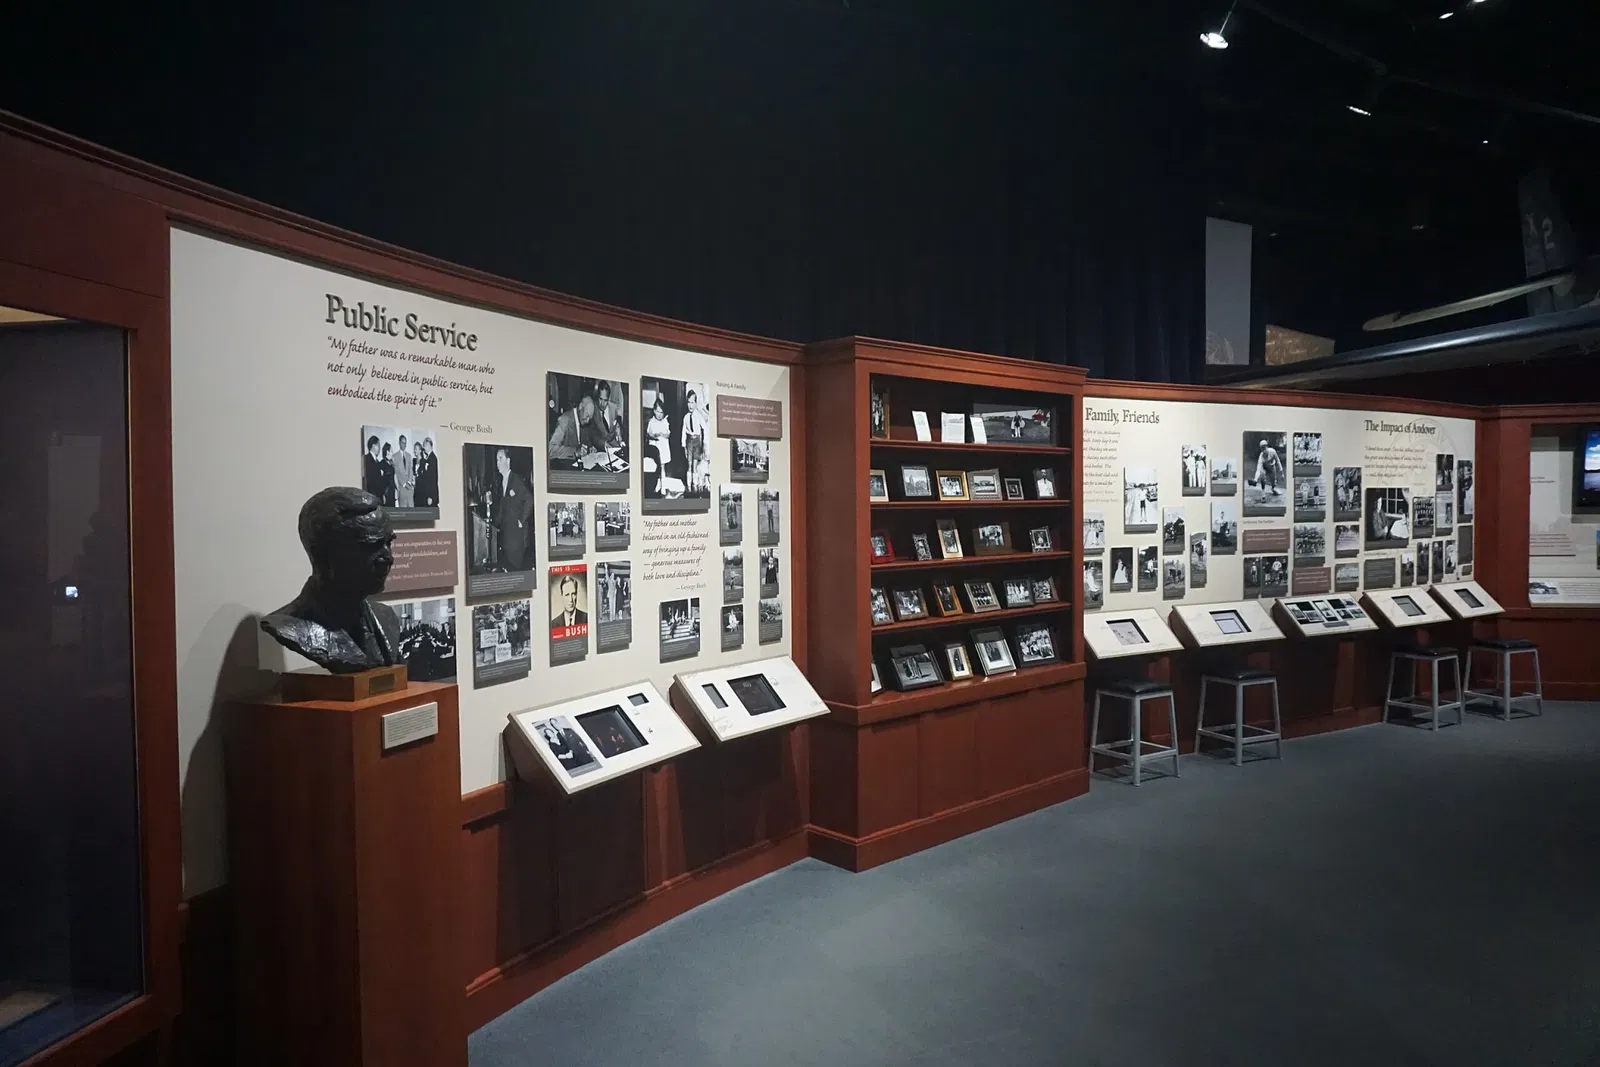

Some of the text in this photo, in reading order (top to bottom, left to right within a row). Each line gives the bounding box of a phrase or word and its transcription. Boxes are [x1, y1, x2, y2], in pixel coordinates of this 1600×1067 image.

[325, 293, 478, 352] Public Service
[346, 339, 378, 358] father
[380, 349, 397, 360] was
[400, 352, 406, 360] a
[408, 354, 456, 369] remarkable
[458, 362, 478, 373] man
[479, 362, 495, 375] who
[327, 361, 494, 395] not only believed in public service, but
[716, 380, 730, 389] Raising
[328, 384, 375, 400] embodied
[376, 389, 393, 402] the
[394, 393, 418, 409] spirit
[419, 394, 429, 413] of
[1085, 407, 1160, 426] Family, Friends
[450, 422, 475, 434] George
[476, 424, 492, 434] Bush
[1365, 420, 1436, 436] The Impact of Andover
[652, 519, 668, 531] father
[642, 531, 663, 541] believed
[642, 549, 652, 557] way
[653, 546, 659, 557] of
[659, 545, 679, 556] bringing
[680, 547, 686, 555] up
[690, 544, 706, 555] family
[651, 560, 673, 571] generous
[696, 556, 701, 567] of
[643, 573, 654, 581] both
[655, 572, 664, 580] love
[566, 625, 587, 637] BUSH
